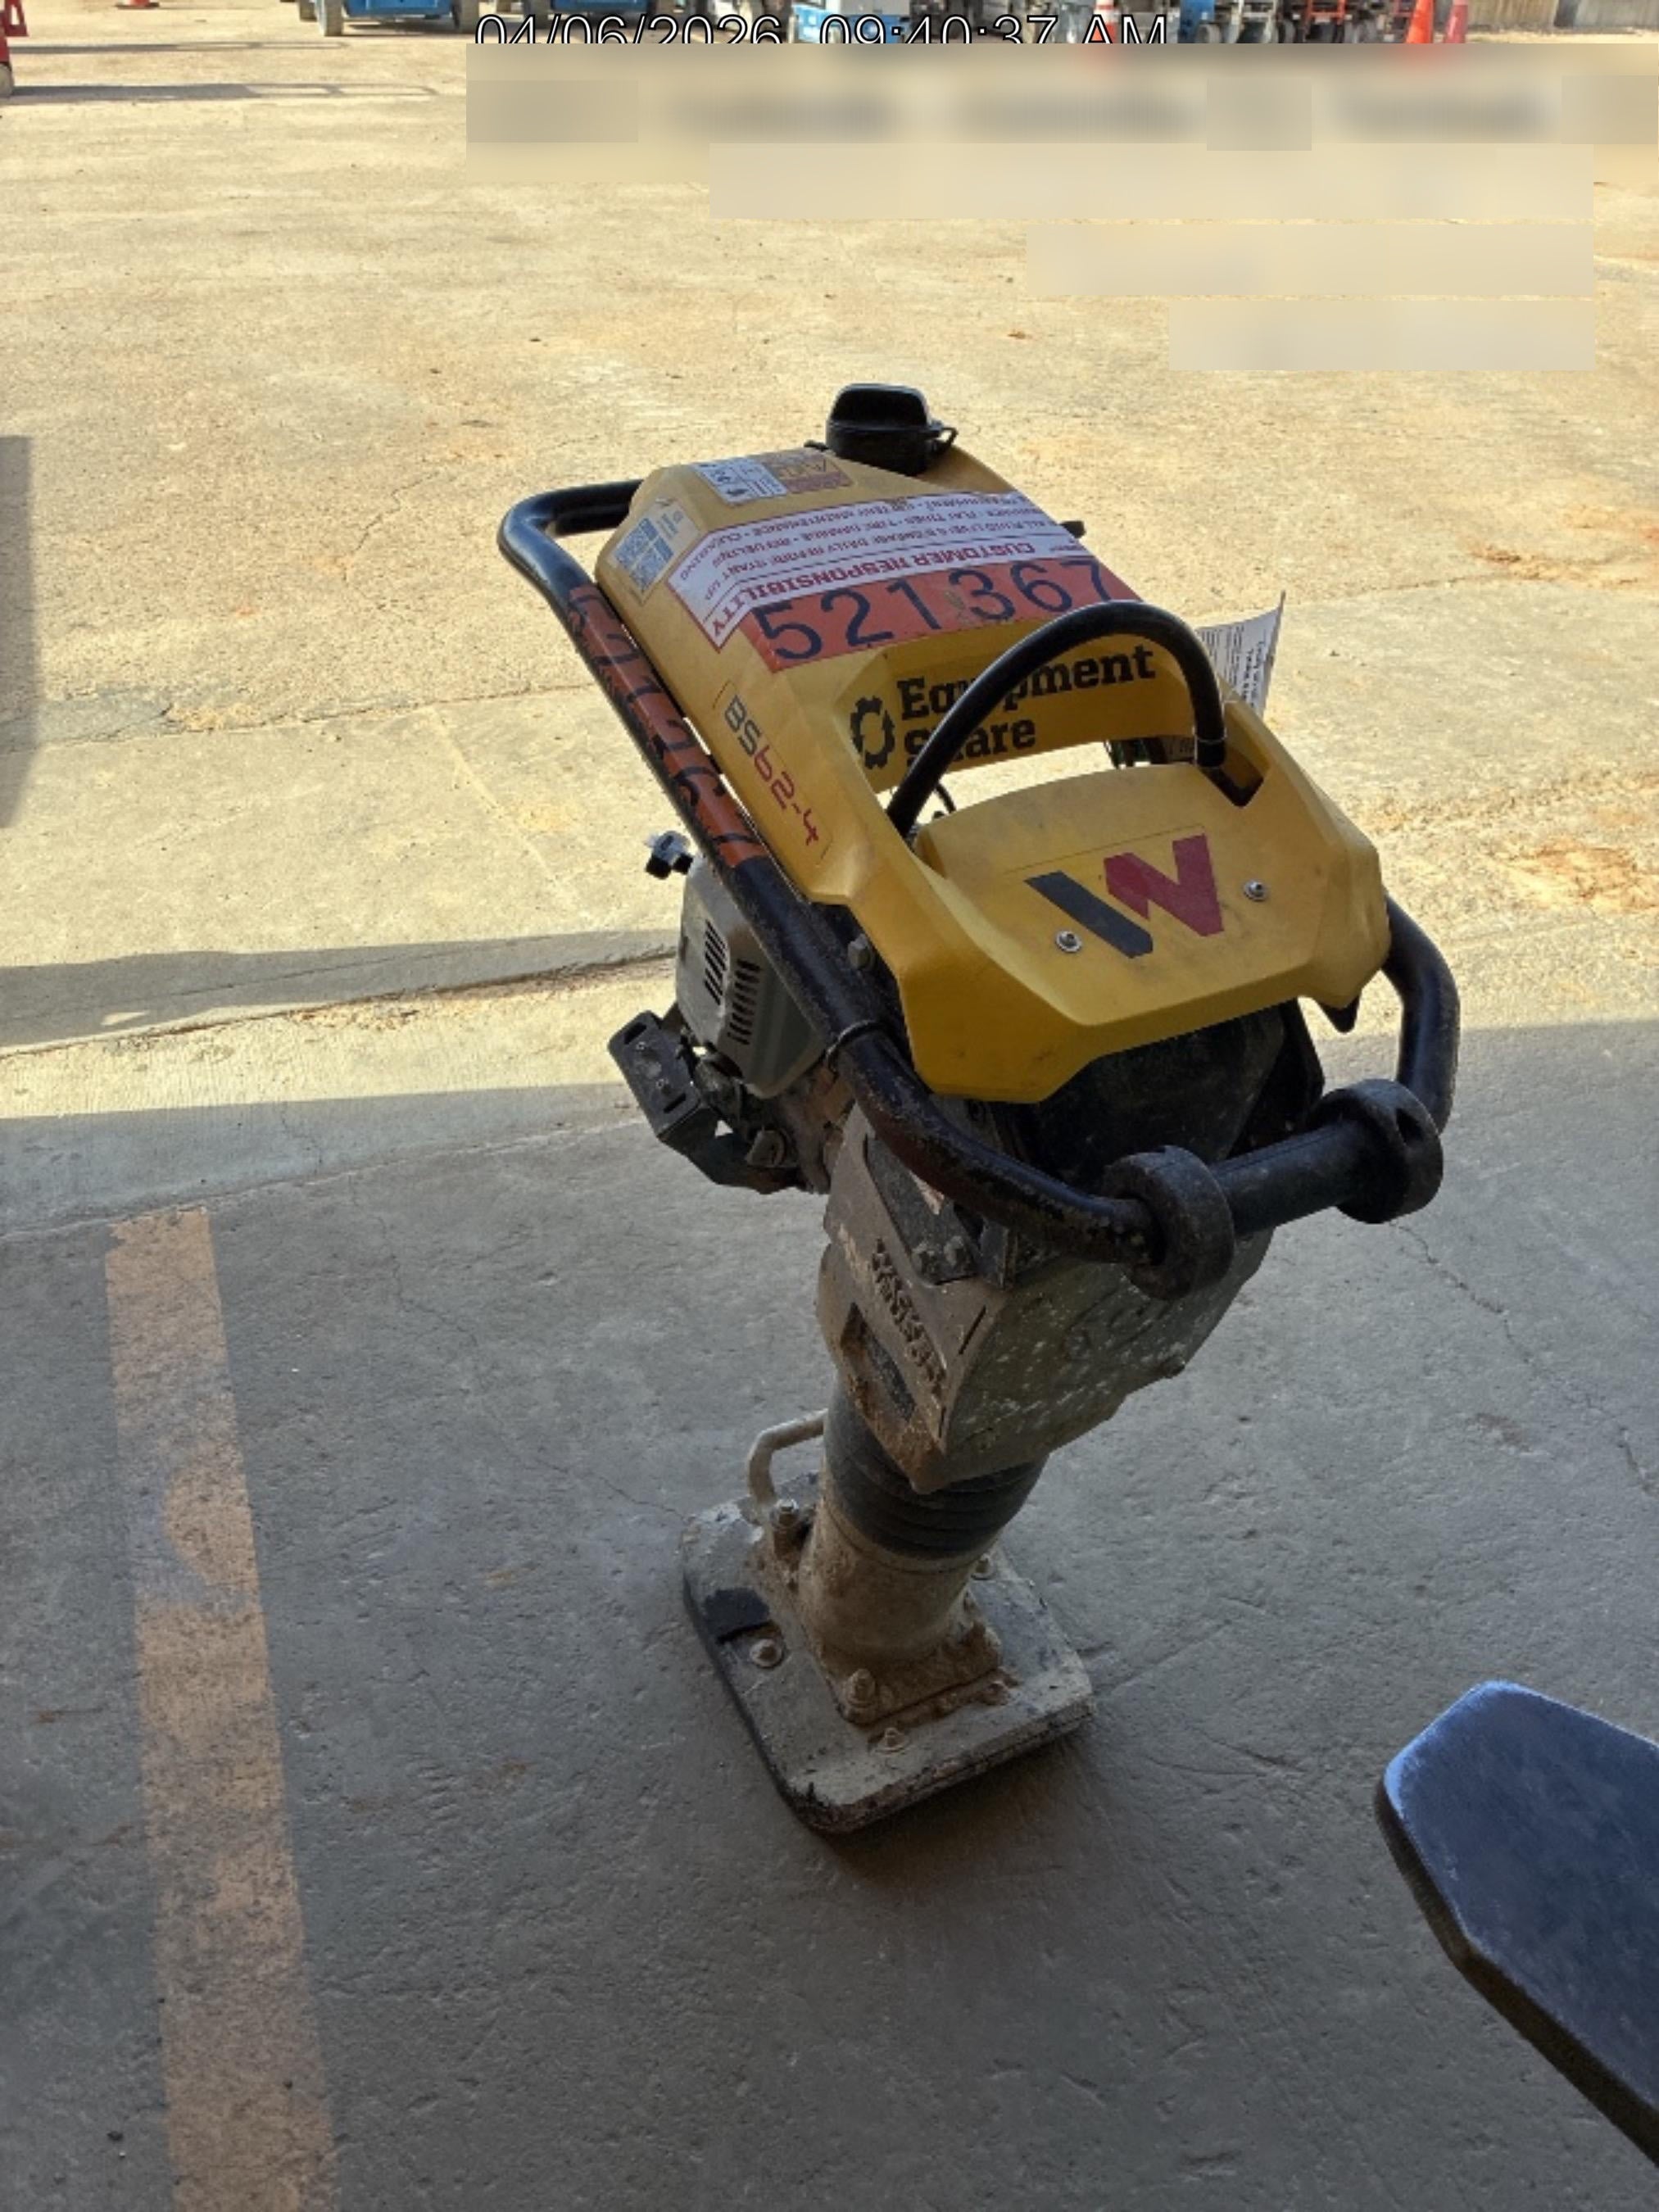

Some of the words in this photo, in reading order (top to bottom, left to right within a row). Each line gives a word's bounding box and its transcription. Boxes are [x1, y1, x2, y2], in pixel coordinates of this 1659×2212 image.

[911, 542, 1036, 567] CUSTOMER
[712, 559, 911, 635] RESPONSIBILITY
[750, 560, 1113, 659] 521367
[897, 644, 1156, 721] Eqpment
[904, 718, 1036, 767] sare
